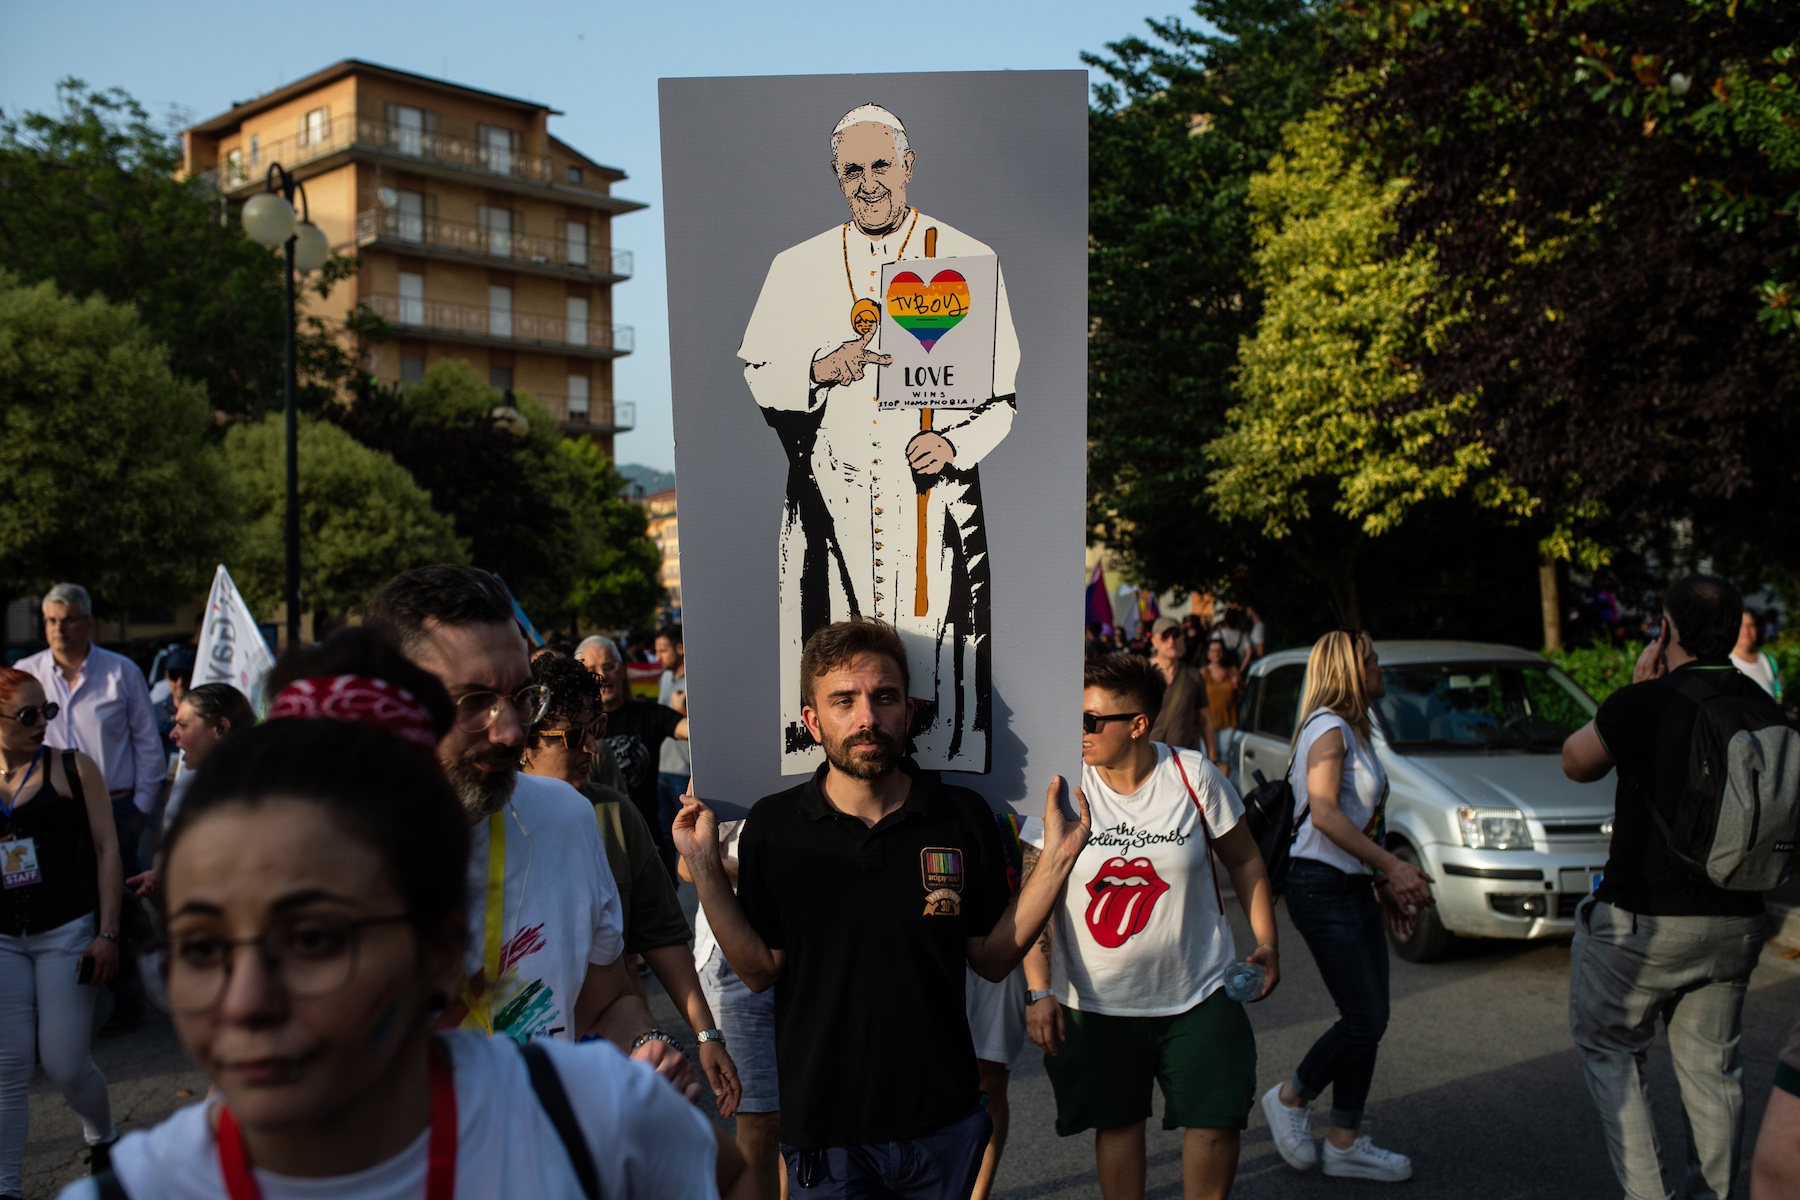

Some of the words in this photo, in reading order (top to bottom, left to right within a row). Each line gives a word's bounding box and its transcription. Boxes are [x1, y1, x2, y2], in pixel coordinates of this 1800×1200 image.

[904, 366, 954, 386] LOVE
[1105, 822, 1137, 836] the
[1132, 827, 1190, 848] Stones
[6, 871, 37, 885] STAFF
